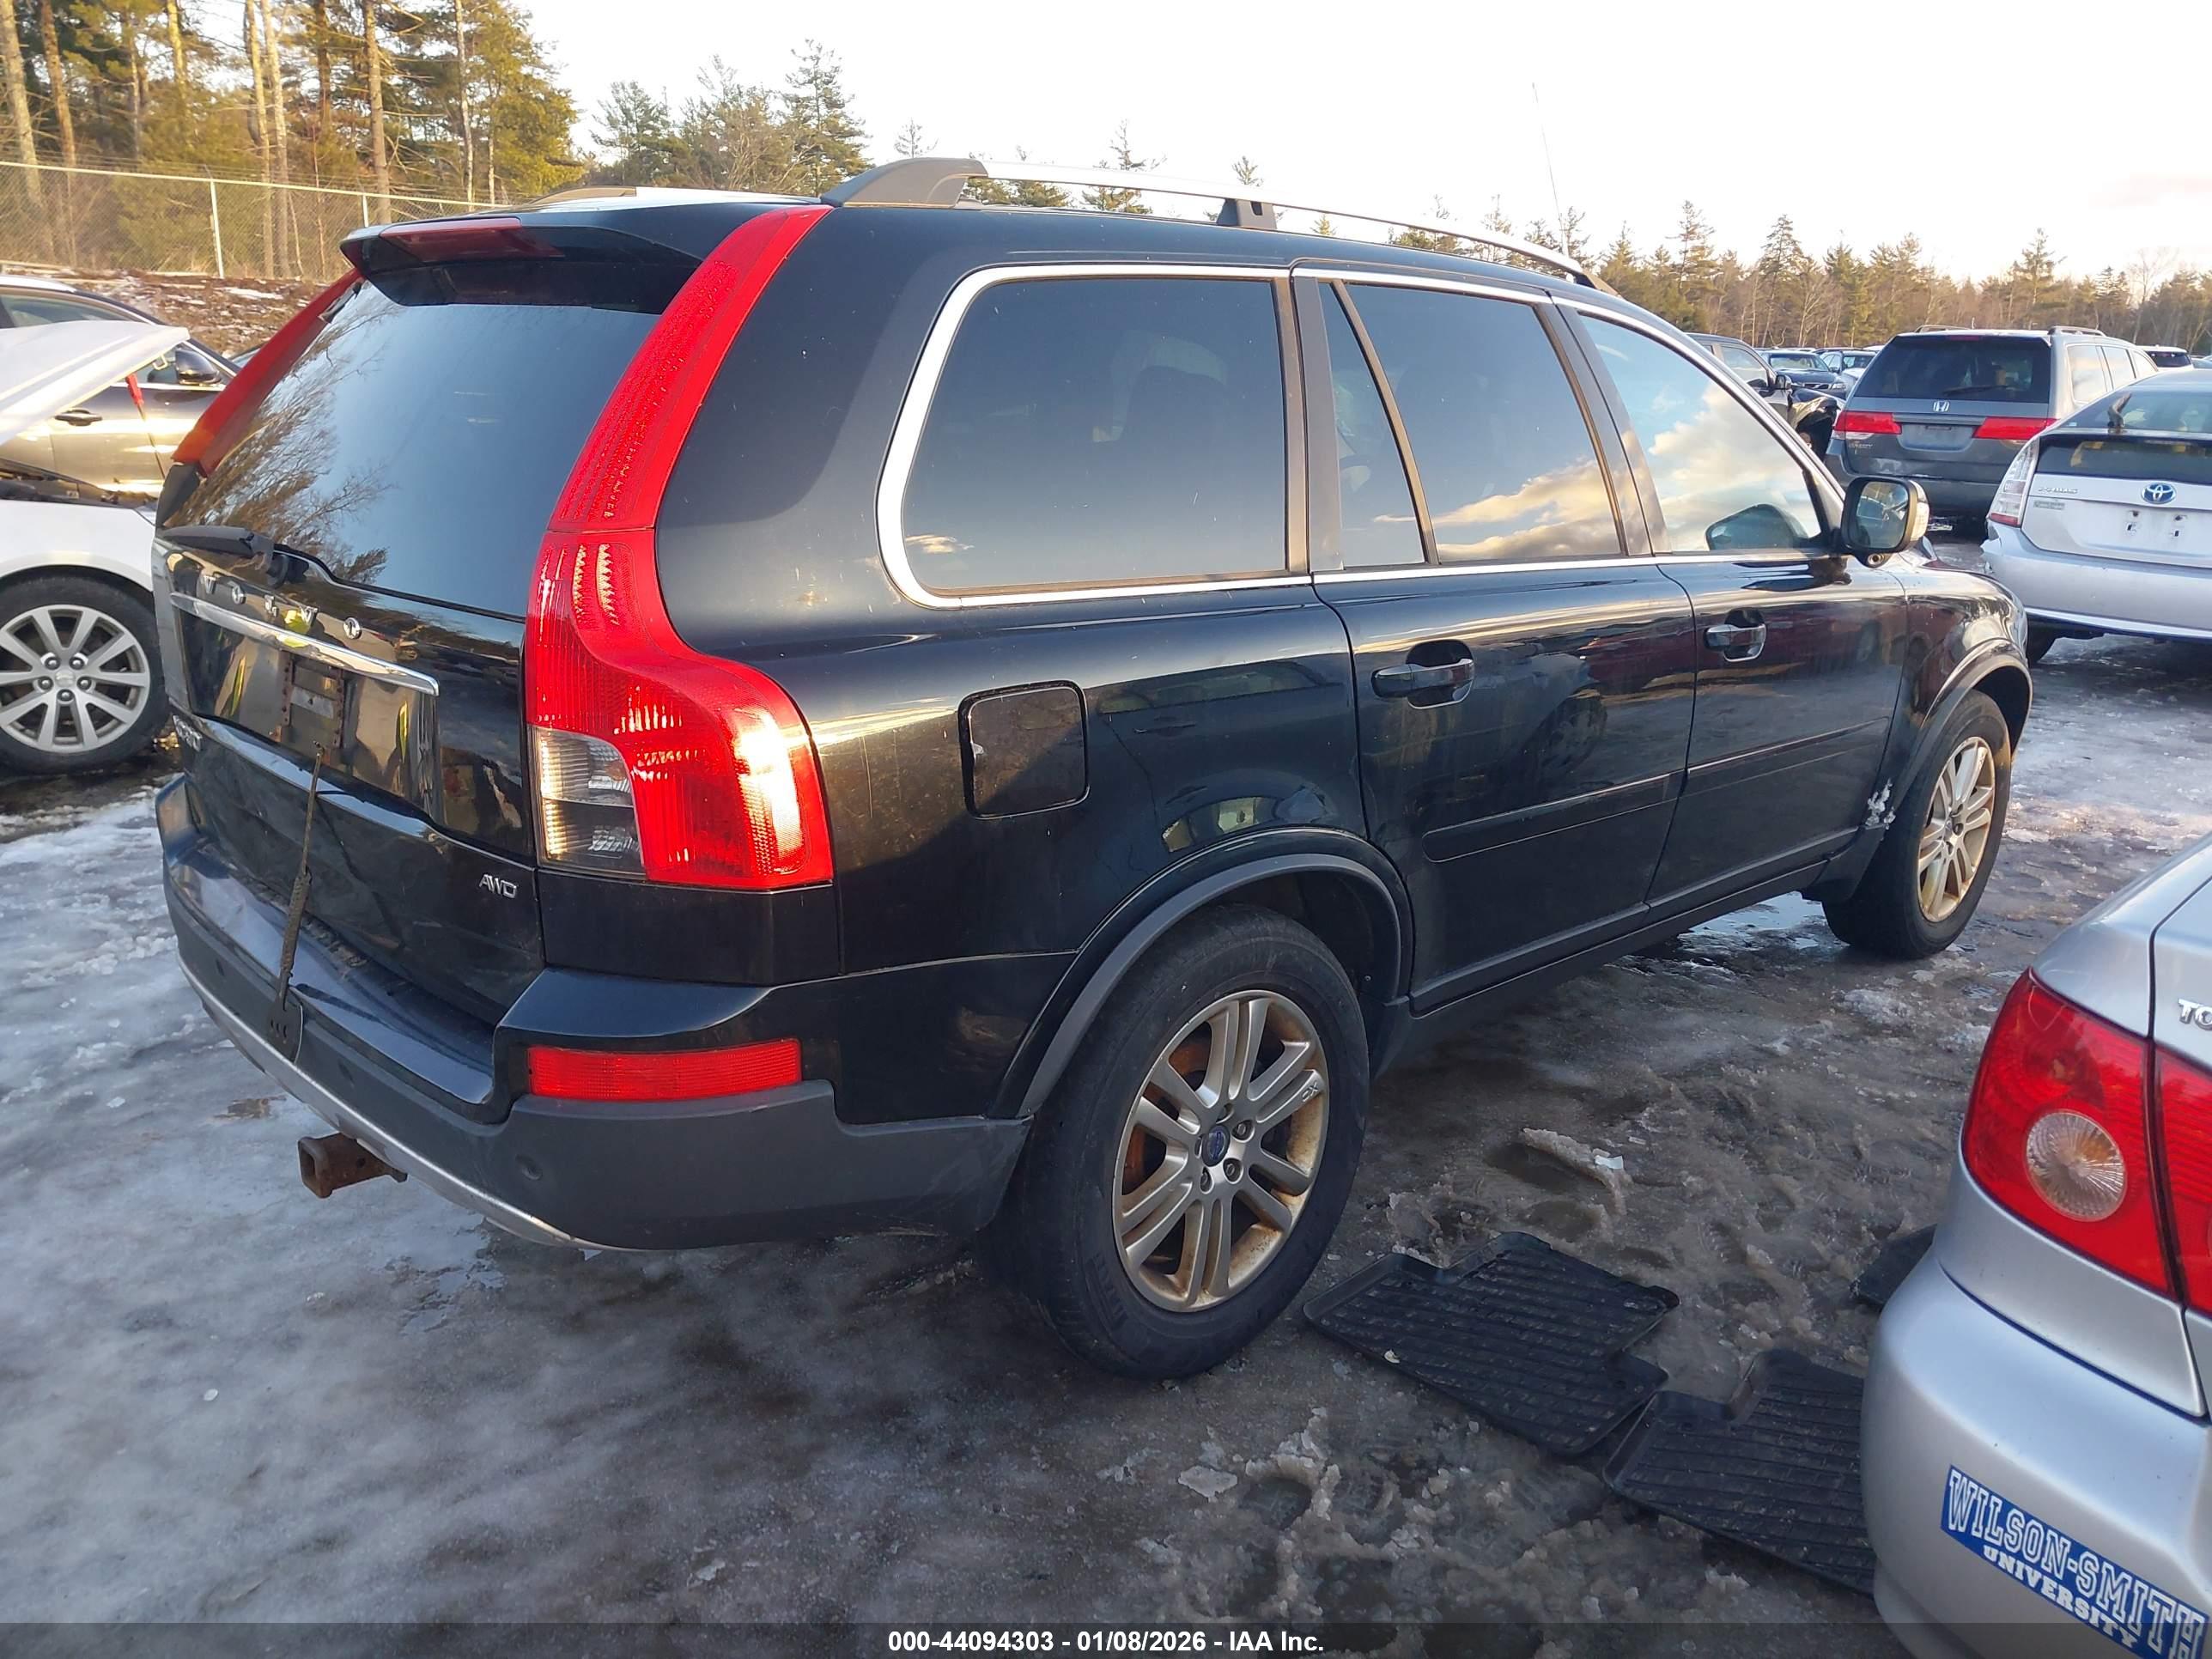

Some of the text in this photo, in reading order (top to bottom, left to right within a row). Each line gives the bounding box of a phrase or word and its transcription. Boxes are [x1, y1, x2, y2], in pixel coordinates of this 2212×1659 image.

[203, 574, 362, 641] VOLVO
[478, 873, 517, 898] AWD
[1948, 1468, 2206, 1659] WILSON-SMITH
[1982, 1544, 2139, 1649] UNIVERSITY
